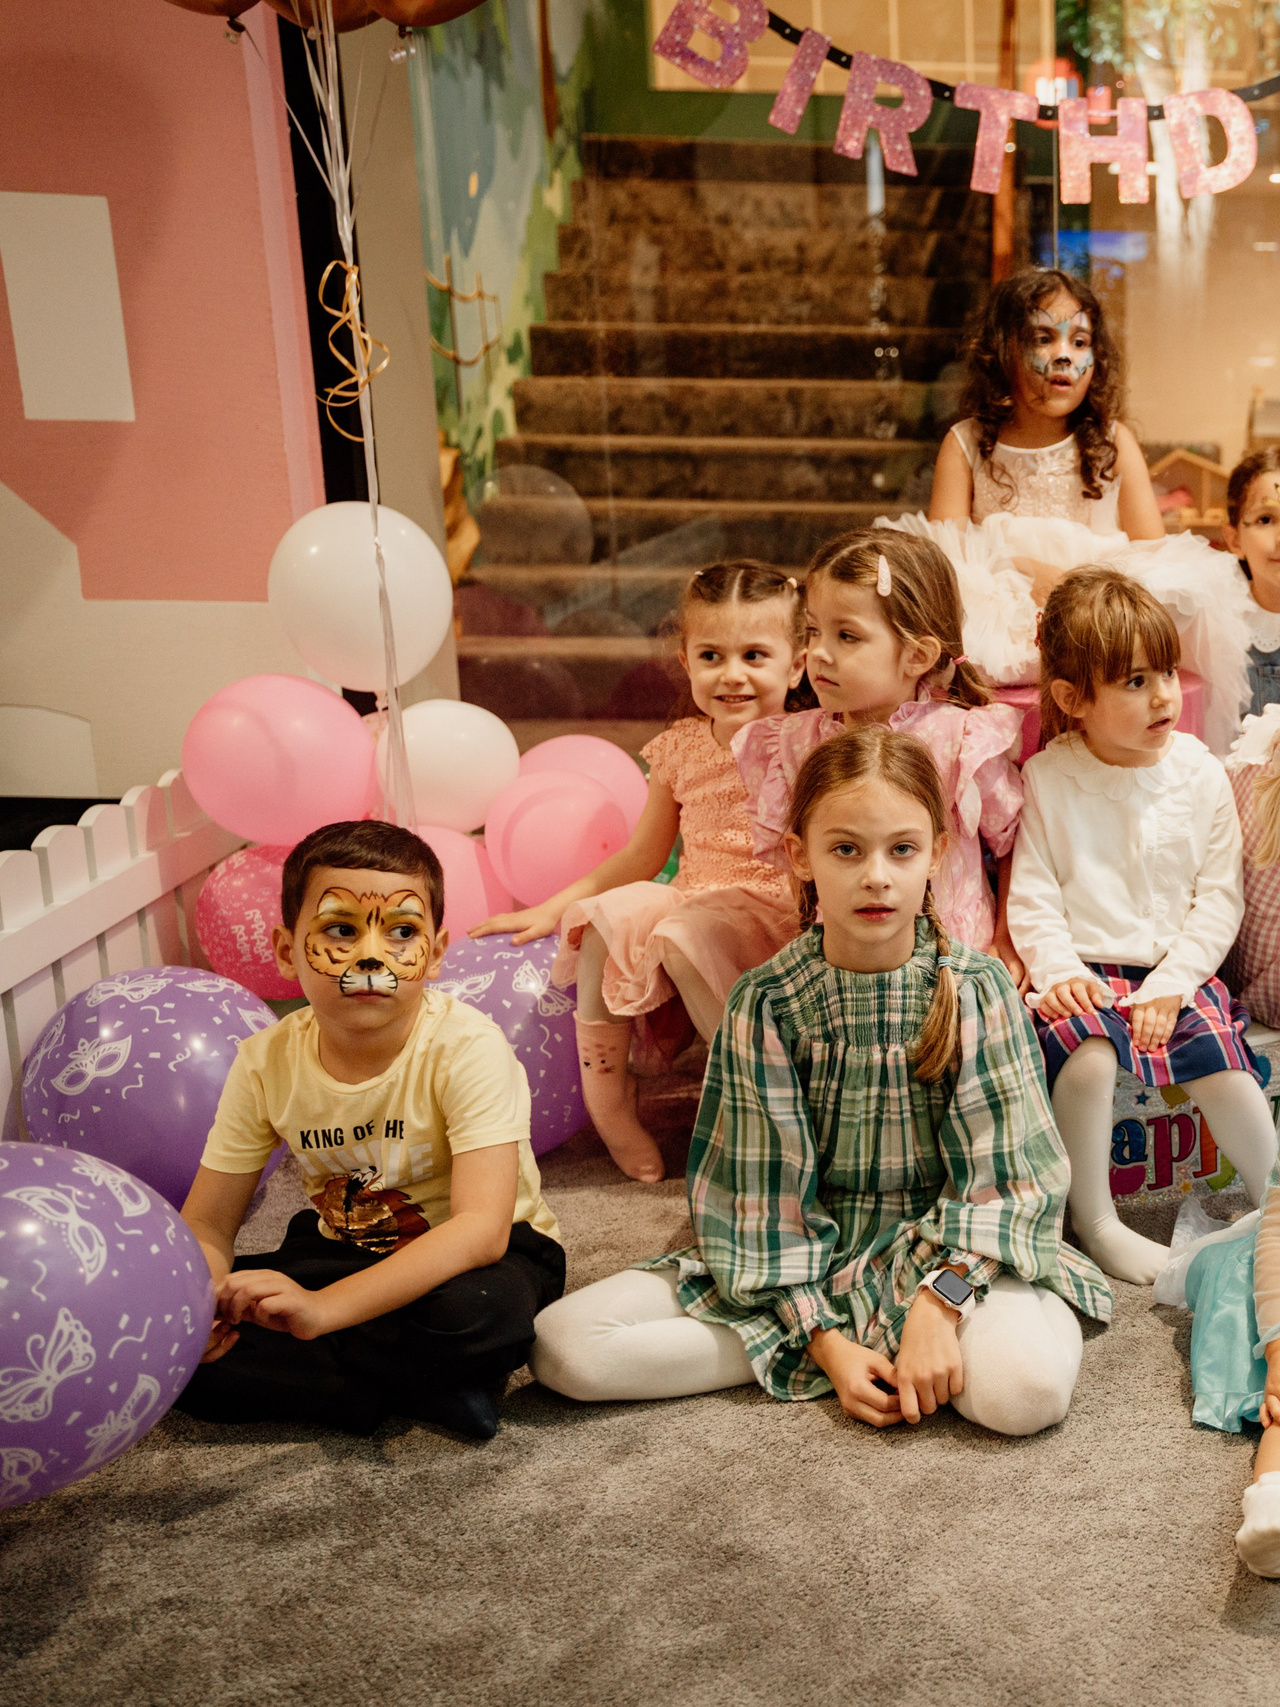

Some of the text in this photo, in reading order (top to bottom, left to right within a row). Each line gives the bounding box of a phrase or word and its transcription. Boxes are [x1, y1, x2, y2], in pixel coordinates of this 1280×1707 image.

[300, 1118, 404, 1149] KING OF HE
